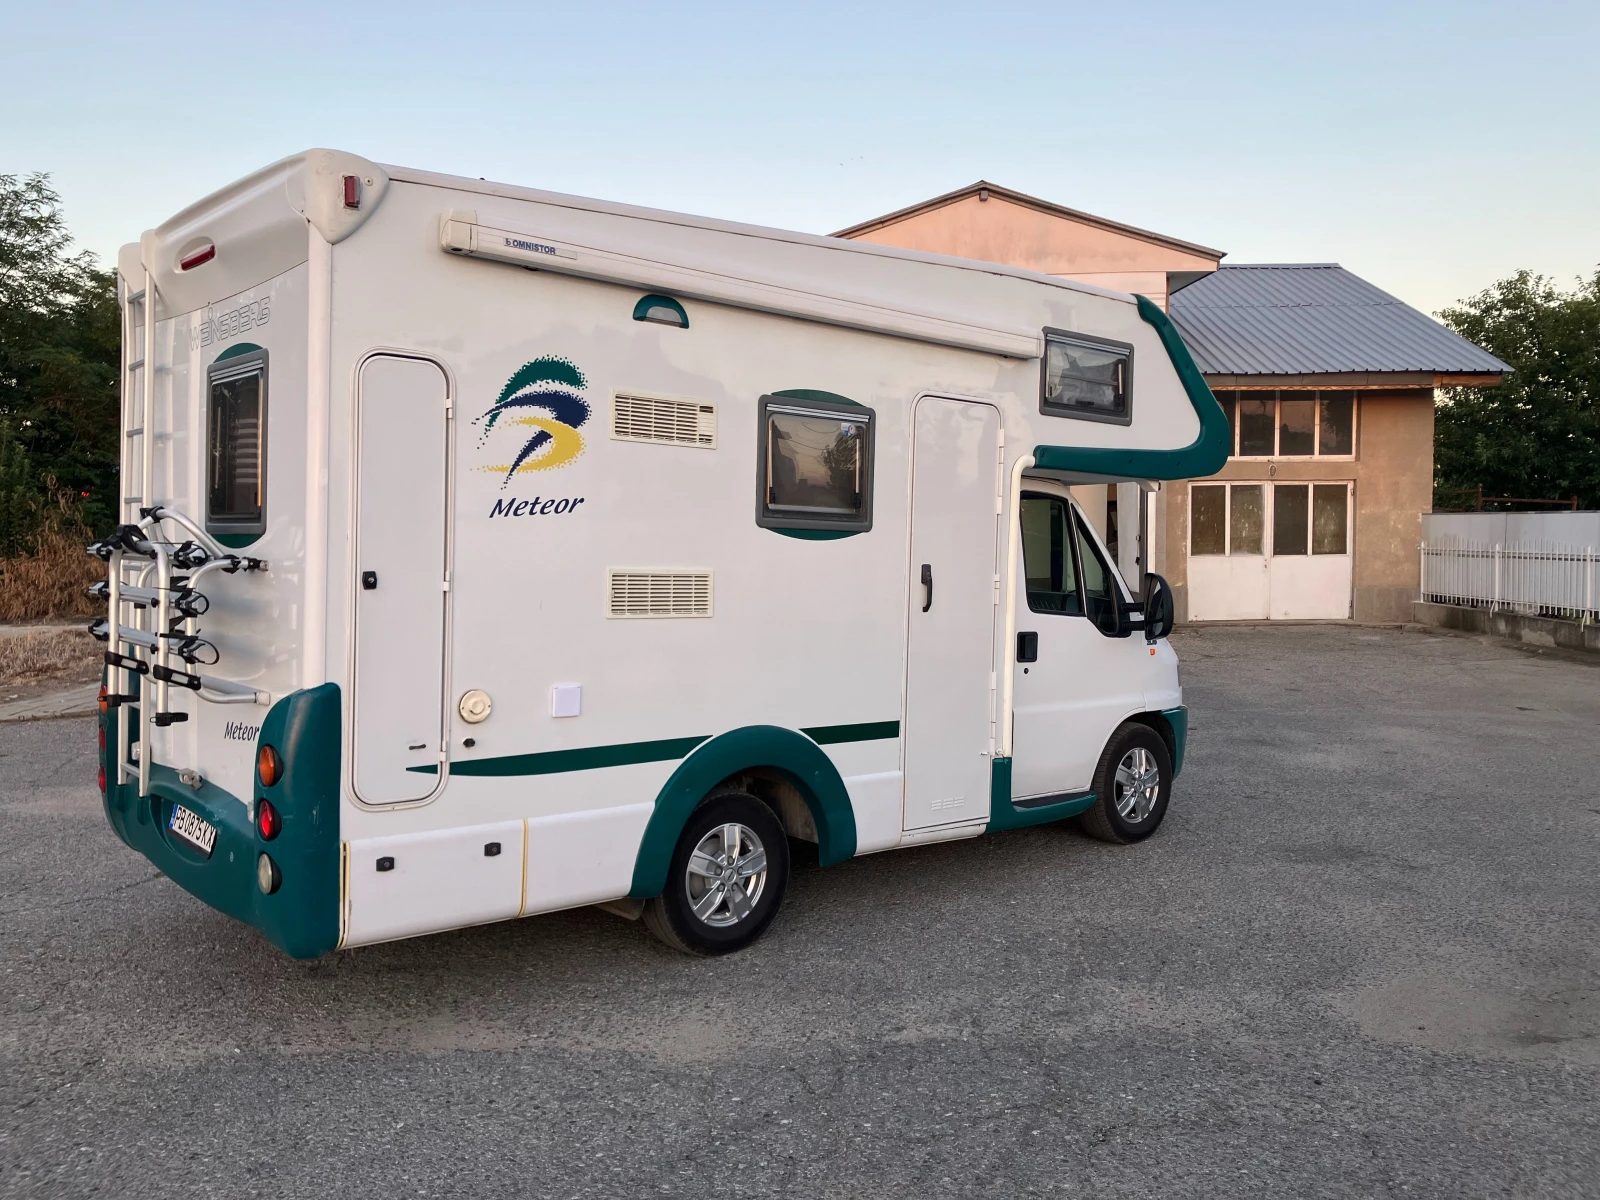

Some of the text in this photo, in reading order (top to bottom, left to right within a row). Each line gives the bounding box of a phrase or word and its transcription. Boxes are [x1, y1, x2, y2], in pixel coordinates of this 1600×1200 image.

[512, 240, 556, 255] OMNISTOR
[488, 496, 585, 518] Meteor
[223, 721, 260, 742] Meteor
